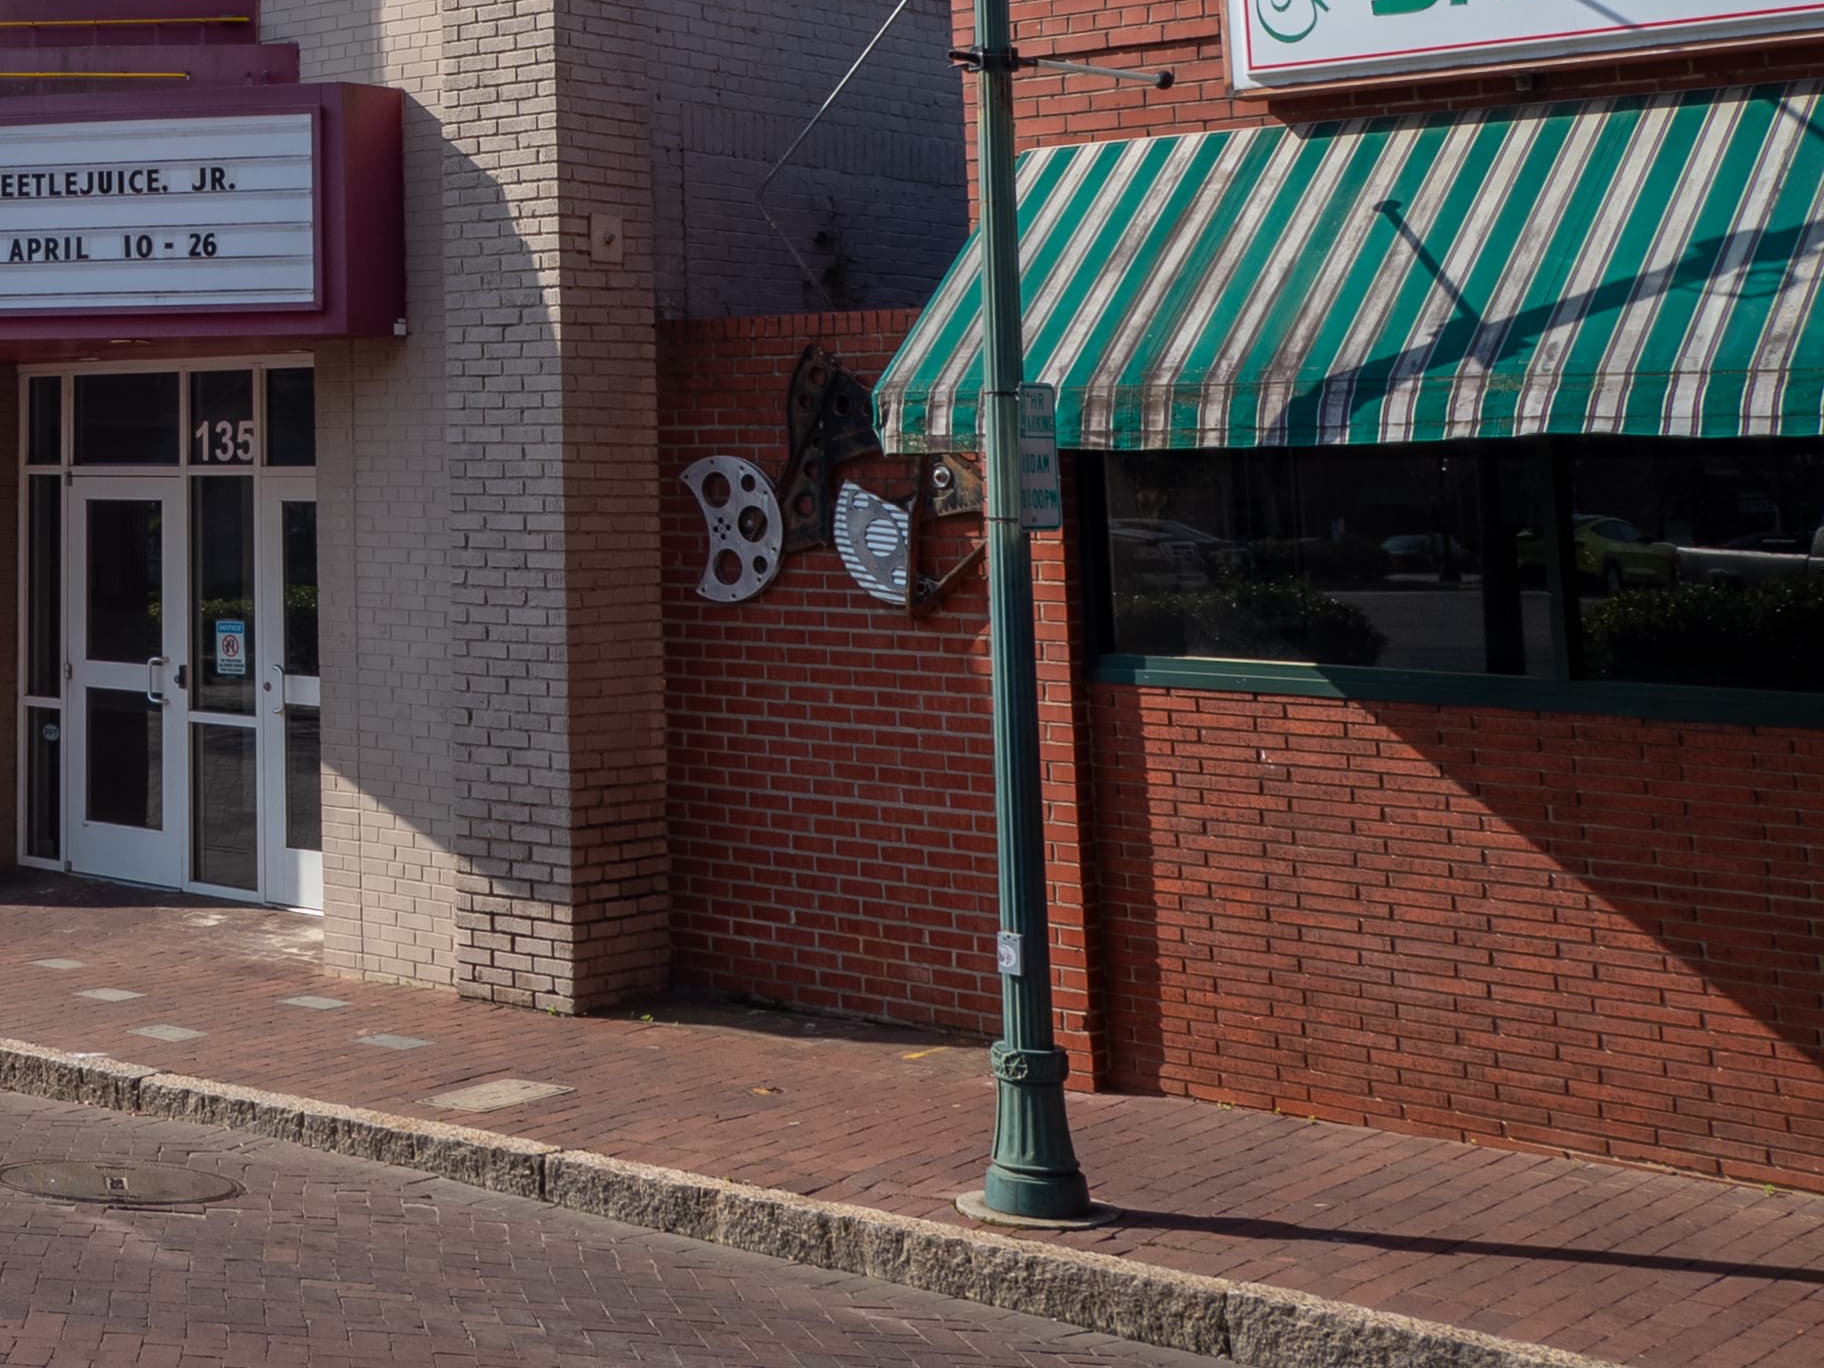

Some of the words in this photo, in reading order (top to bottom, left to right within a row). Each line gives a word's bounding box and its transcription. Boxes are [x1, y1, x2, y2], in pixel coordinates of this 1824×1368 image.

[192, 166, 236, 192] JR.
[9, 236, 89, 262] APRIL
[124, 234, 153, 258] 10
[188, 232, 217, 257] 26
[195, 420, 255, 461] 135
